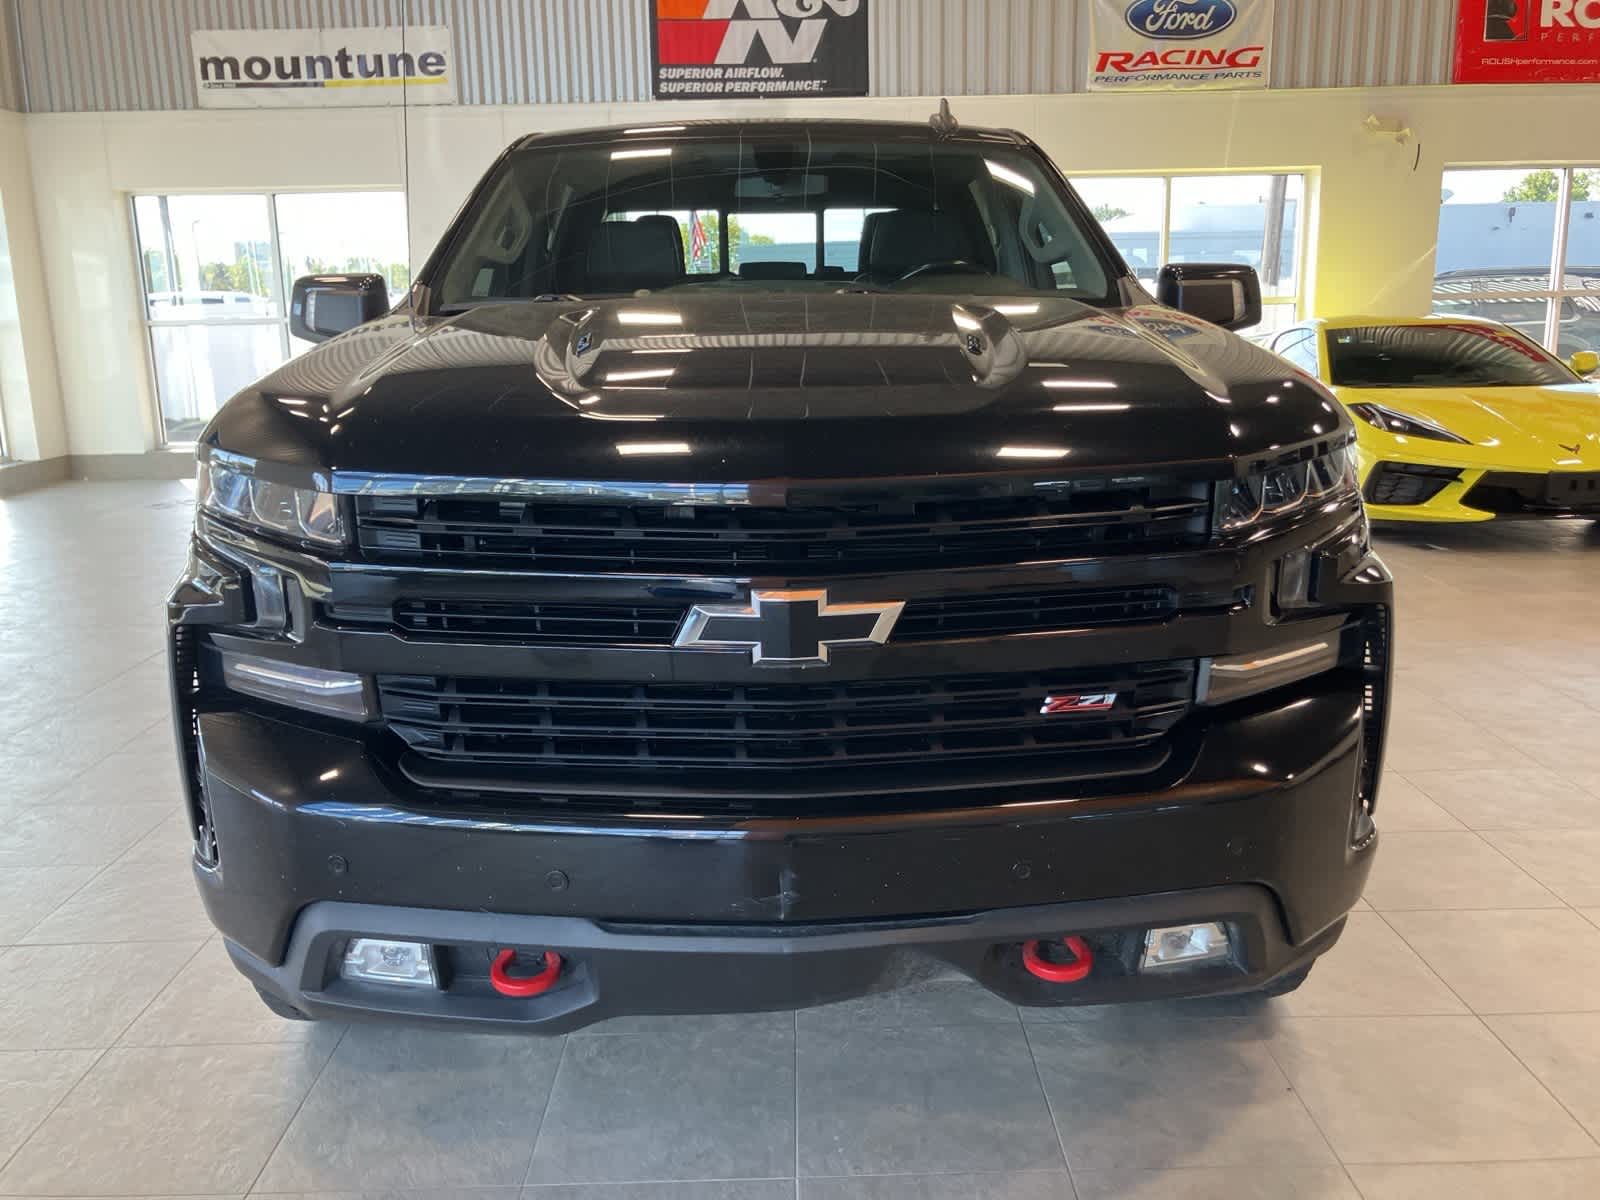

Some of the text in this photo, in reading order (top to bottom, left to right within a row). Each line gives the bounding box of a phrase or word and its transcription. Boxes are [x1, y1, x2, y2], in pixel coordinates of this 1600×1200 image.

[1145, 0, 1216, 31] Ford
[200, 46, 447, 81] mountune
[1095, 46, 1265, 73] RACING
[659, 67, 784, 79] SUPERIOR AIRFLOW.
[1094, 71, 1262, 83] PERFORMANCE PARTS
[659, 81, 725, 93] SUPERIOR
[1040, 693, 1117, 714] Z71
